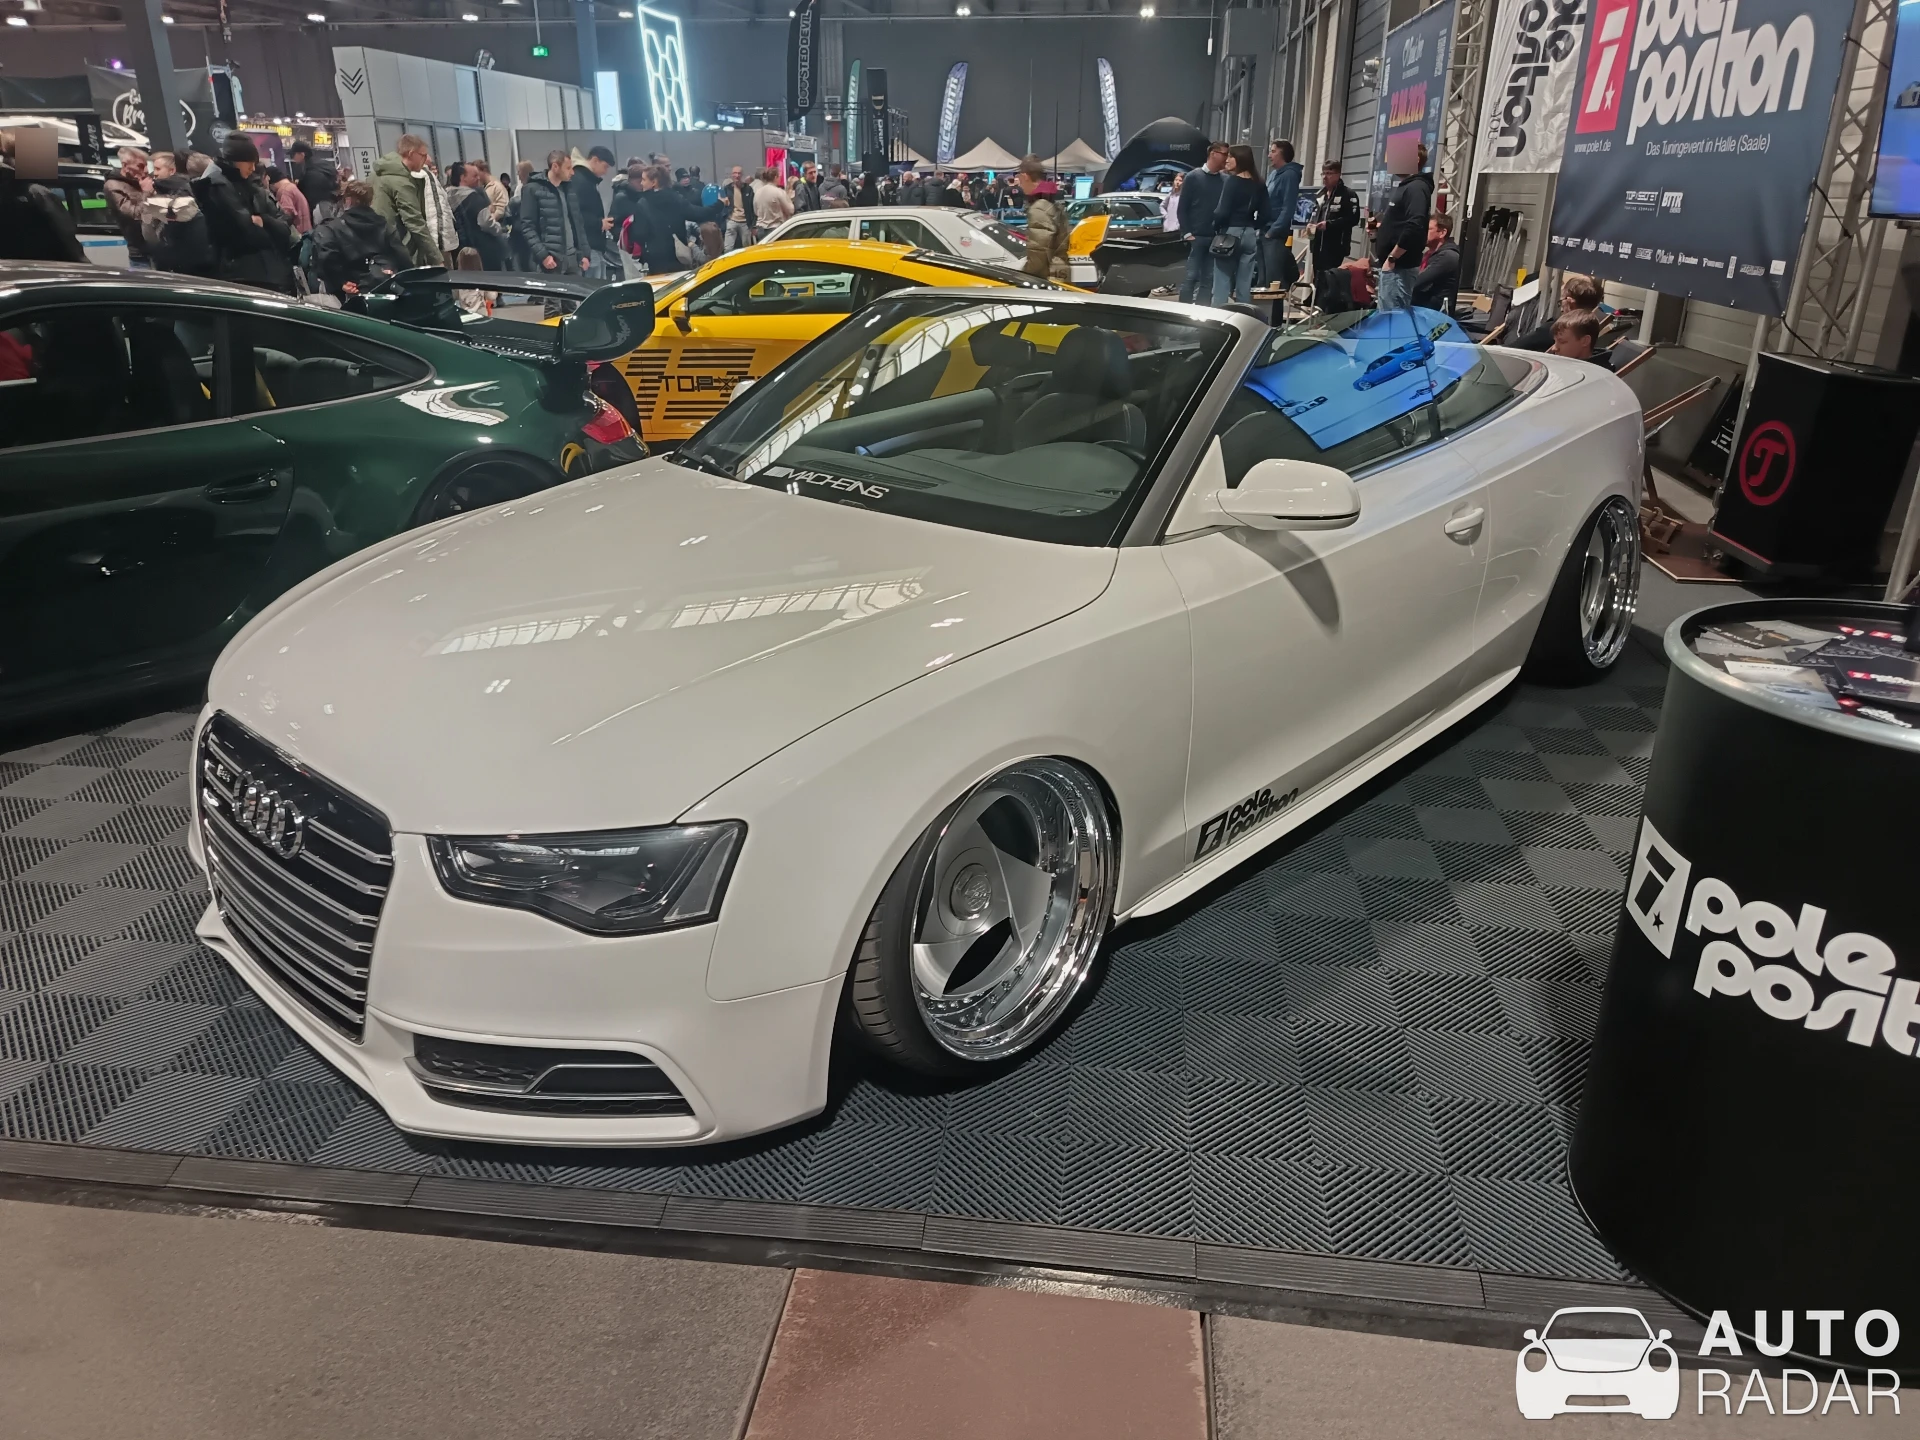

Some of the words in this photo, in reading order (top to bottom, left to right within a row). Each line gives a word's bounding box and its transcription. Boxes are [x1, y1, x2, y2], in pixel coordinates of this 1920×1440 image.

[799, 10, 813, 49] DEVIL
[1573, 139, 1612, 155] www.pole1.de
[1645, 141, 1661, 156] Das
[1661, 138, 1704, 158] Tuningevent
[1704, 136, 1713, 150] in
[1715, 136, 1736, 153] Halle
[1736, 133, 1771, 155] (Saale)
[1226, 788, 1271, 832] pole
[1685, 877, 1897, 996] pole
